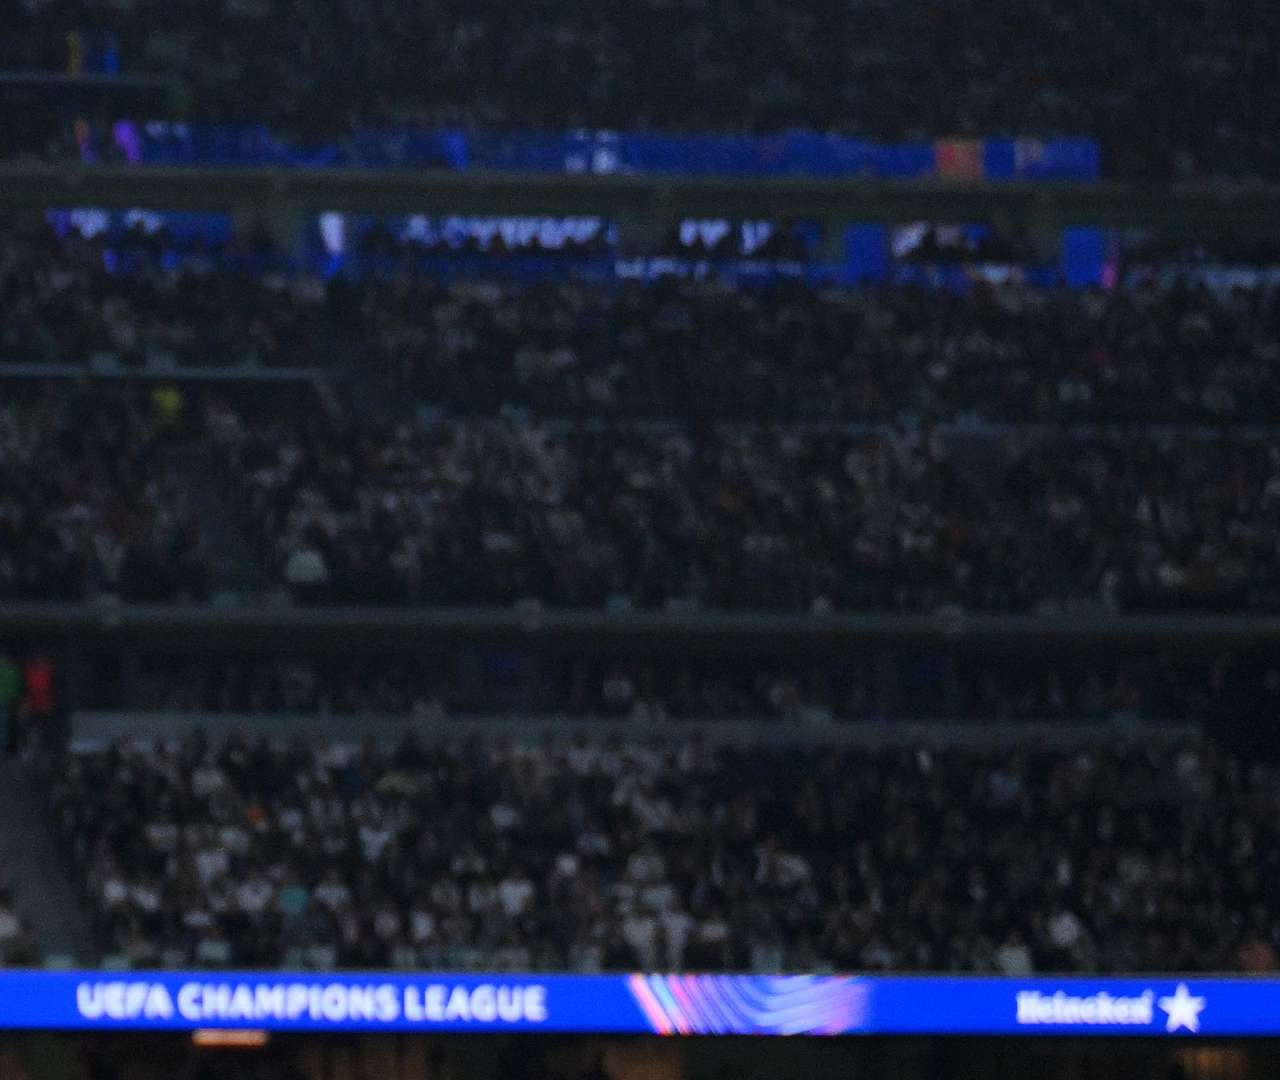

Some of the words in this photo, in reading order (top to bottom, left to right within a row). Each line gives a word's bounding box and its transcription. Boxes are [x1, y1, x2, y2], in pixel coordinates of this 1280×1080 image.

[76, 982, 174, 1020] UEFA
[177, 983, 400, 1022] CHAMPIONS
[404, 985, 548, 1023] LEAGUE
[1016, 989, 1155, 1025] Heineken
